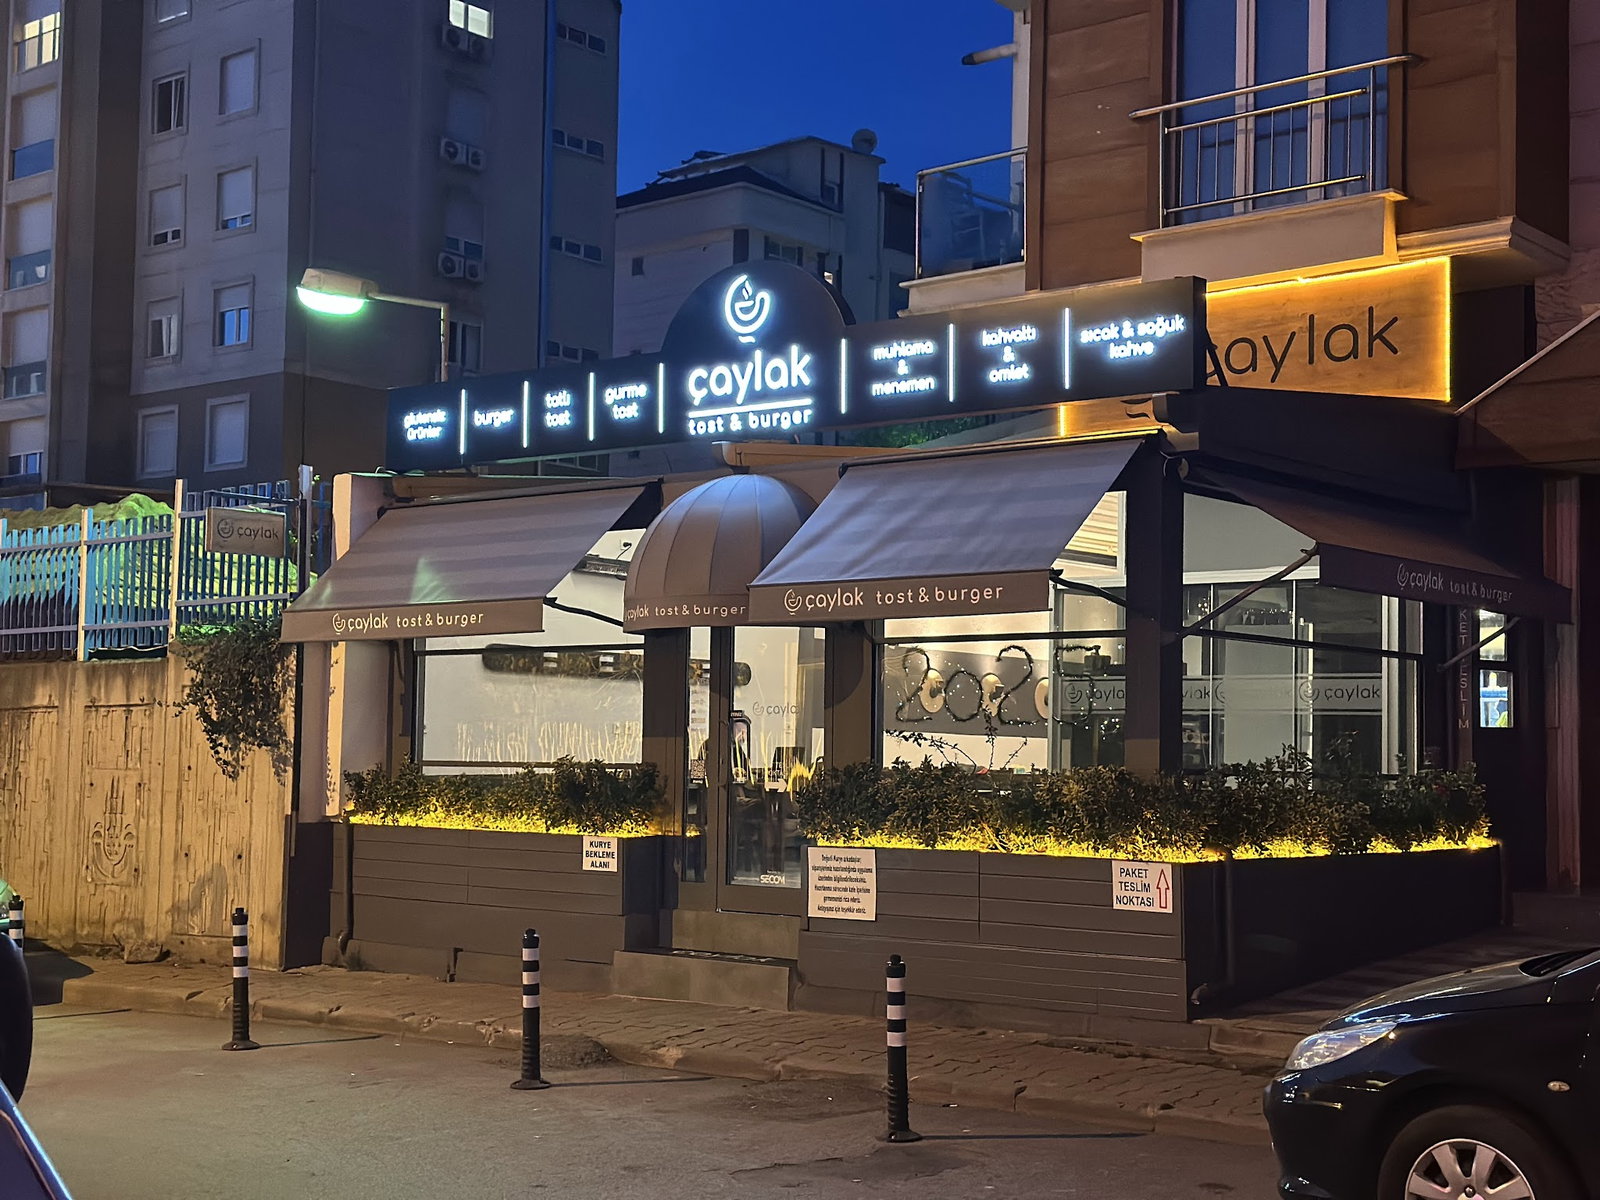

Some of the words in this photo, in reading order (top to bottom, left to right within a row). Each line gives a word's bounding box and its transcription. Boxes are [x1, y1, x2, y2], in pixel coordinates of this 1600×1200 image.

[1122, 321, 1134, 338] &
[873, 341, 934, 360] muhlama
[1003, 346, 1015, 362] &
[1110, 340, 1154, 359] kahve
[688, 344, 811, 406] çaylak
[898, 359, 908, 375] &
[989, 363, 1029, 382] omlet
[605, 384, 647, 404] gurme
[872, 377, 935, 396] menemen
[474, 409, 514, 428] burger
[545, 410, 571, 428] tost
[612, 402, 638, 420] tost
[688, 416, 724, 436] tost
[730, 413, 742, 431] &
[749, 409, 813, 430] burger
[237, 526, 279, 541] çaylak
[1410, 570, 1444, 592] çaylak
[805, 587, 864, 612] çaylak
[876, 589, 913, 605] tost
[918, 587, 930, 603] &
[935, 586, 1004, 604] burger
[655, 605, 679, 616] tost
[681, 604, 690, 615] &
[693, 604, 746, 617] burger
[347, 612, 389, 634] çaylak
[396, 615, 422, 628] tost
[425, 613, 433, 626] &
[436, 612, 484, 628] burger
[1324, 684, 1380, 702] çaylak
[590, 841, 611, 849] KURYE
[585, 850, 615, 859] BEKLEME
[590, 861, 610, 869] ALANI
[1119, 867, 1149, 879] PAKET
[1118, 880, 1151, 893] TESLİM
[1115, 895, 1154, 907] NOKTASI
